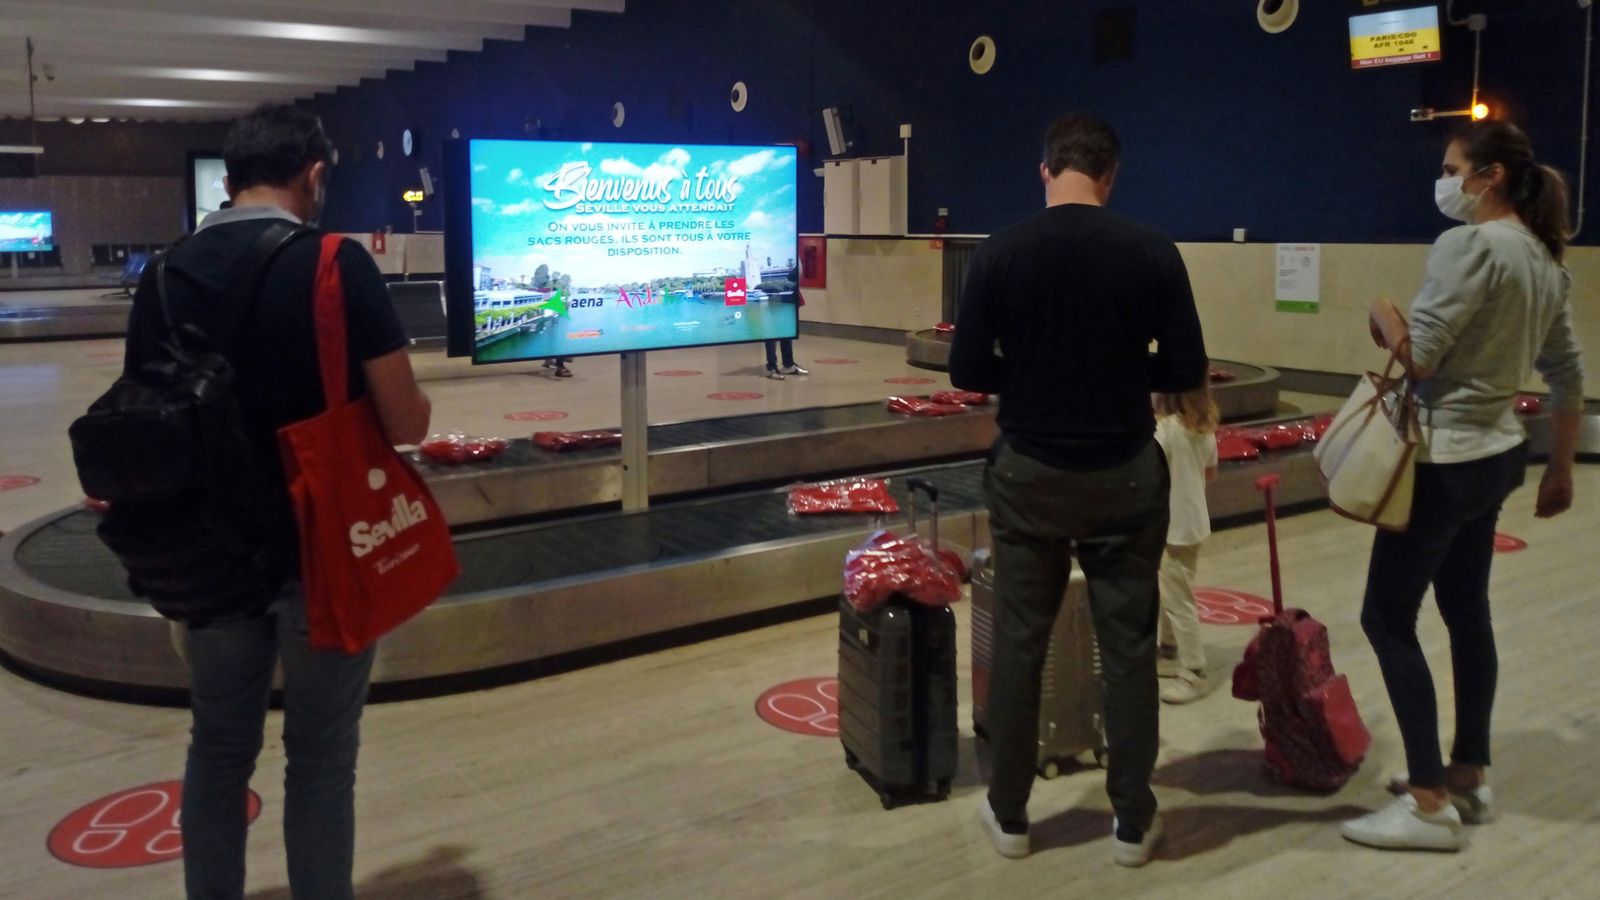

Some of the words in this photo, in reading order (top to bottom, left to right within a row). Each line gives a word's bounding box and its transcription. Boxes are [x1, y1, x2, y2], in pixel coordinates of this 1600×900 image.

[543, 161, 673, 210] Bienvenus
[680, 168, 691, 201] à
[695, 166, 738, 204] tous
[633, 203, 666, 213] VOUS
[669, 202, 735, 212] ATTENDAIT
[571, 222, 604, 232] VOUS
[607, 222, 646, 231] INVITE
[658, 220, 713, 230] PRENDRE
[714, 220, 735, 229] LES
[527, 236, 562, 246] SACS
[621, 234, 639, 244] ILS
[641, 234, 672, 243] SONT
[674, 233, 704, 242] TOUS
[716, 231, 751, 241] VOTRE
[607, 246, 683, 257] DISPOSITION.
[570, 297, 604, 309] aena
[349, 493, 428, 558] Sevilla
